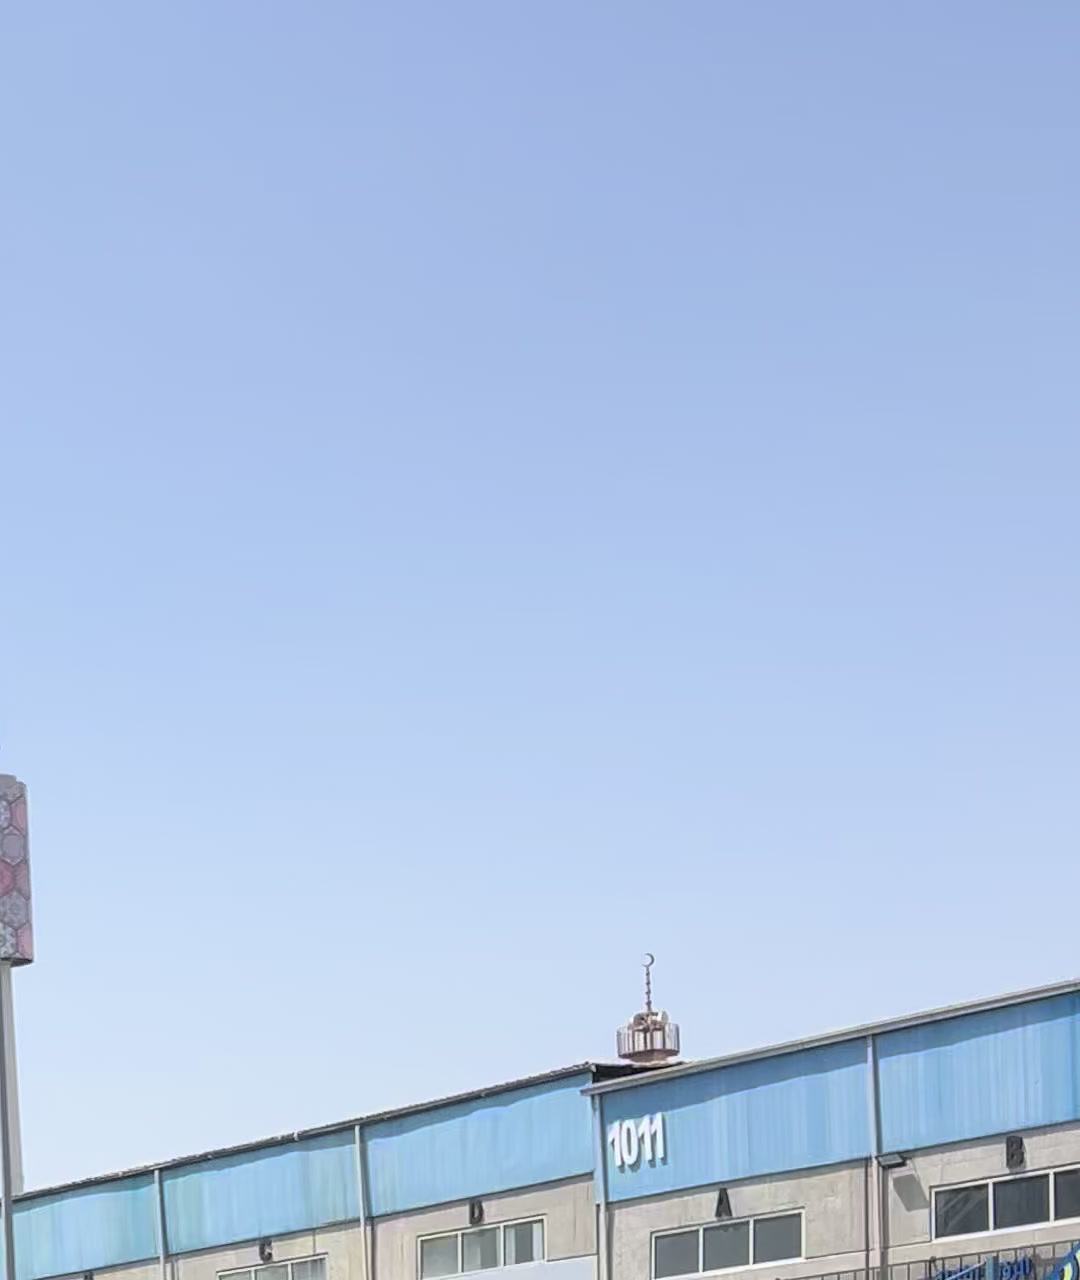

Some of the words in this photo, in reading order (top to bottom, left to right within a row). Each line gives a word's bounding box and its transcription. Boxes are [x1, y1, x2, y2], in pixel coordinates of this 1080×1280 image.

[608, 1112, 665, 1168] 1011
[1006, 1136, 1025, 1169] B
[716, 1188, 733, 1218] A
